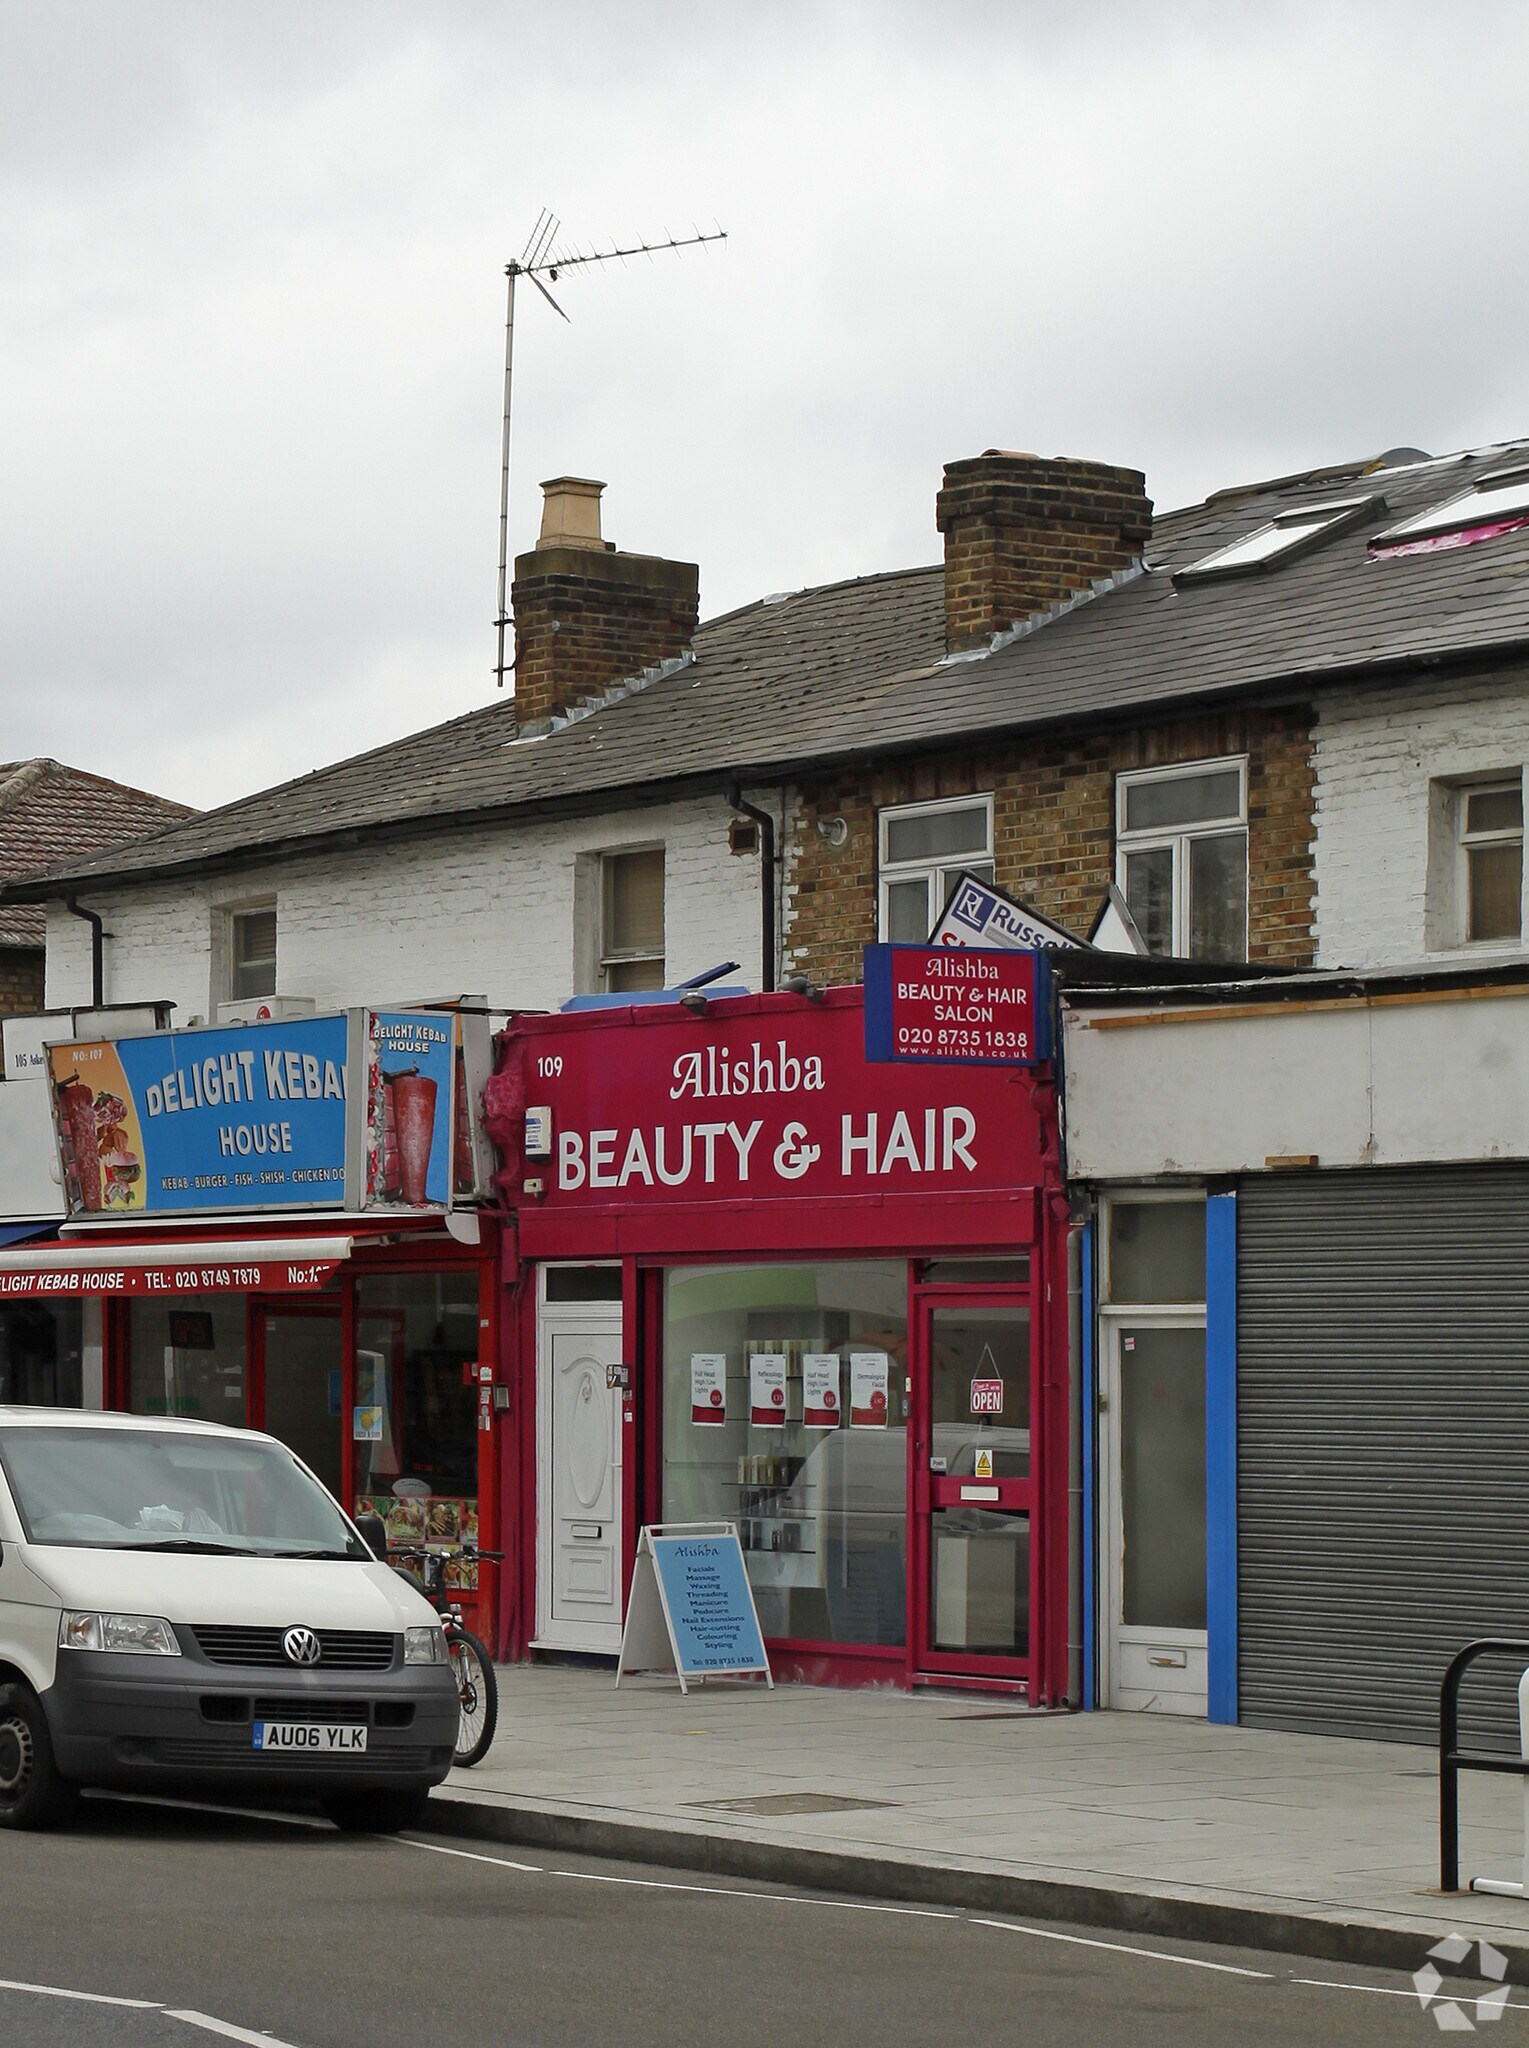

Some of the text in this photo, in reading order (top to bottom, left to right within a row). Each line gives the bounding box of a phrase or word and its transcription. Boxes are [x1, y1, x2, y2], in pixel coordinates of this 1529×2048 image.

[991, 904, 1075, 949] Russ
[925, 957, 999, 980] Alishba
[898, 983, 1027, 1005] BEAUTY & HAIR
[934, 1005, 993, 1023] SALON
[374, 1024, 447, 1043] DELIGHT KEBAB
[899, 1027, 1028, 1048] 020 8735 1838
[388, 1040, 430, 1054] HOUSE
[899, 1046, 1028, 1059] www.alishba.co.uk
[30, 1052, 45, 1066] Aske
[537, 1056, 563, 1078] 109
[669, 1040, 826, 1100] Alishba
[146, 1050, 255, 1117] DELIGHT
[219, 1121, 293, 1157] HOUSE
[558, 1106, 978, 1191] BEAUTY & HAIR
[161, 1175, 189, 1191] KEBAB
[194, 1173, 229, 1189] BURGER
[235, 1172, 253, 1187] FISH
[260, 1169, 285, 1184] SHISH
[292, 1168, 330, 1183] CHICKEN
[0, 1274, 36, 1292] LIGHT
[37, 1273, 79, 1290] KEBAB
[82, 1272, 125, 1289] HOUSE
[145, 1271, 172, 1289] TEL:
[175, 1271, 198, 1288] 020
[201, 1269, 231, 1287] 8749
[232, 1267, 261, 1285] 7879
[973, 1392, 1001, 1410] OPEN
[675, 1544, 720, 1557] Alishba
[686, 1574, 720, 1582] Massage
[686, 1591, 729, 1599] Threading
[690, 1624, 741, 1632] Hair-cutting
[697, 1633, 738, 1641] Colouring
[704, 1642, 734, 1650] Styling
[705, 1658, 717, 1666] 020
[267, 1726, 320, 1747] AU06
[327, 1728, 364, 1748] YLK
